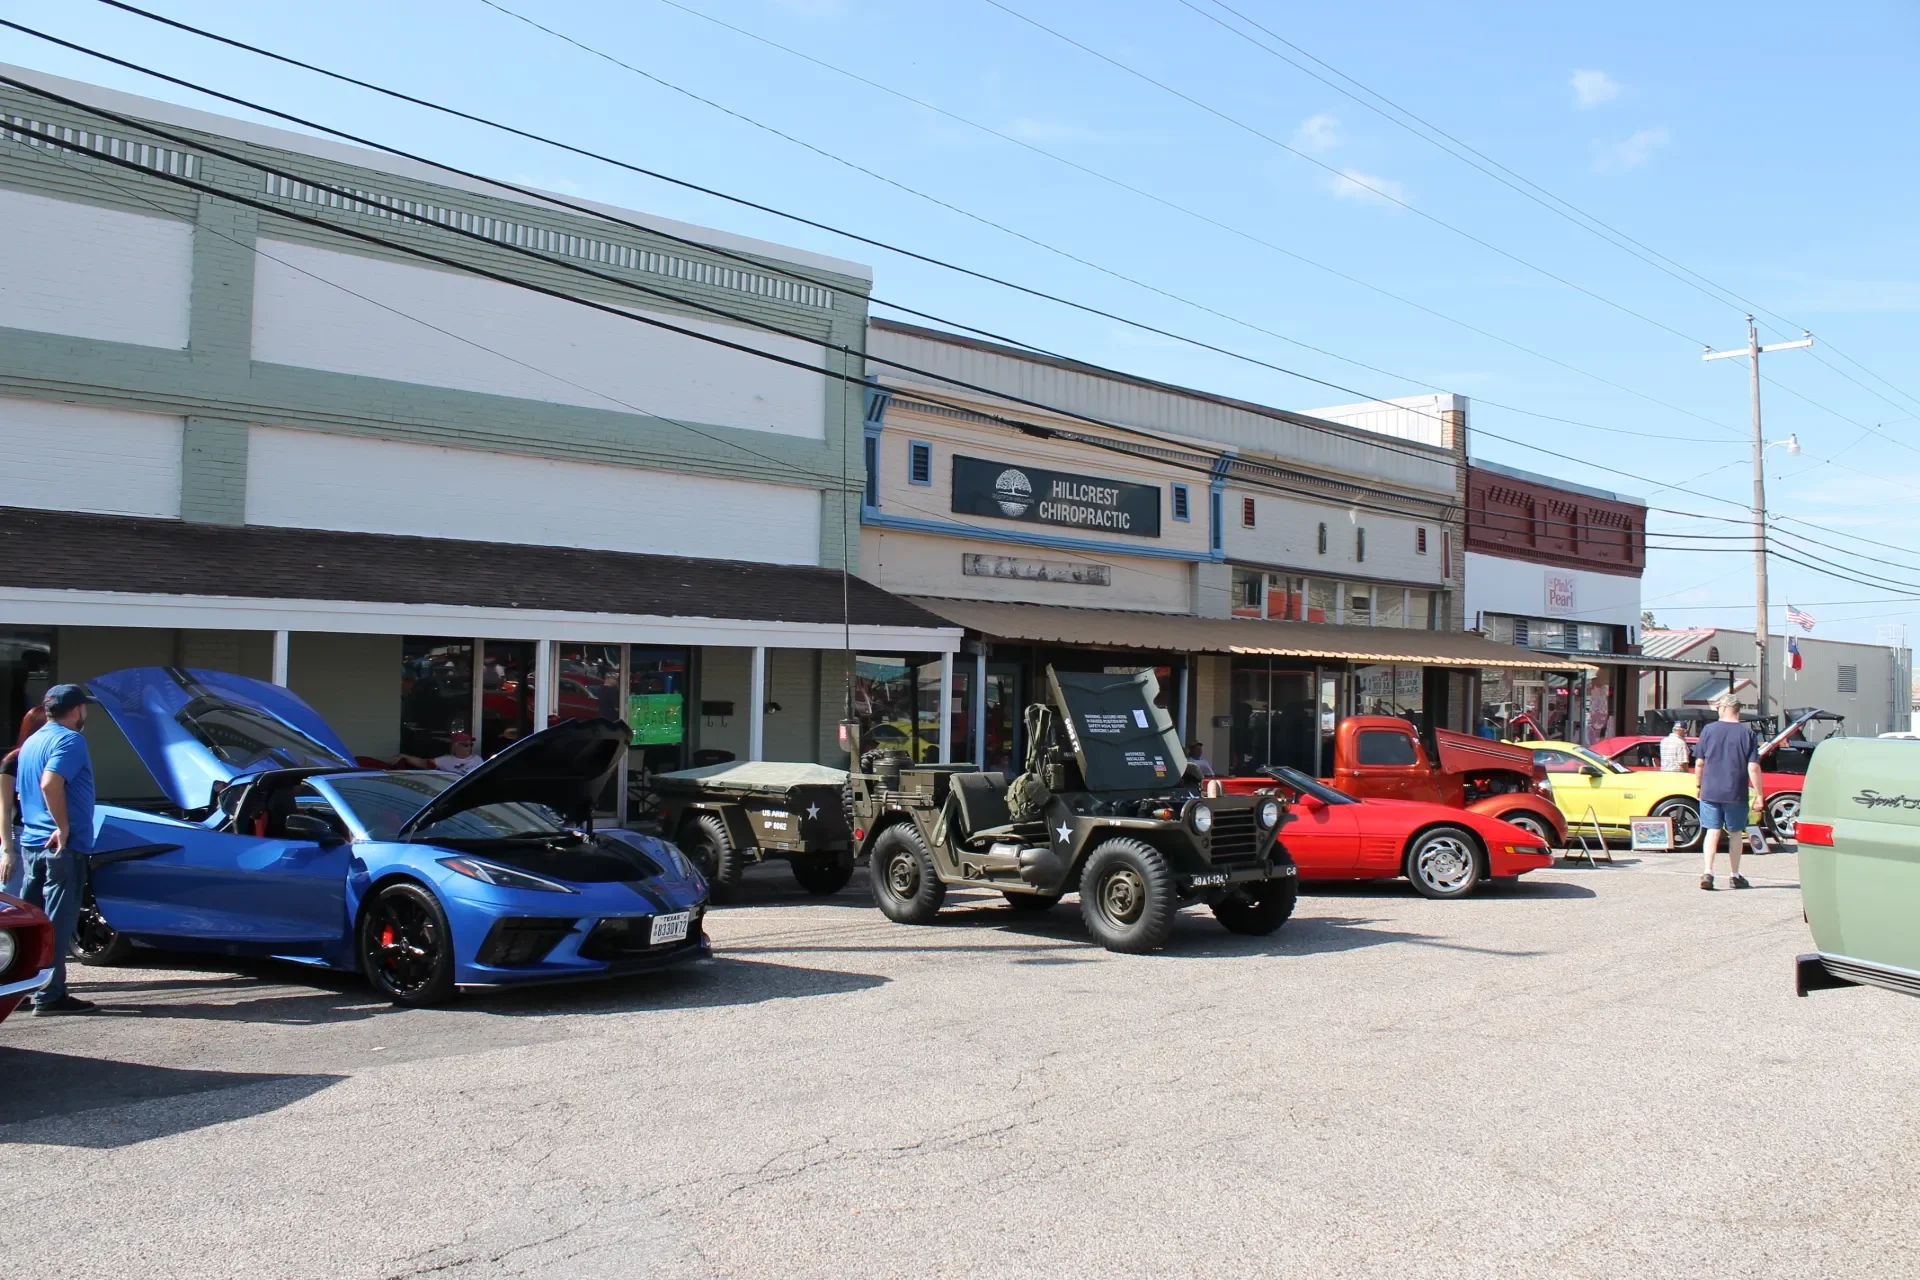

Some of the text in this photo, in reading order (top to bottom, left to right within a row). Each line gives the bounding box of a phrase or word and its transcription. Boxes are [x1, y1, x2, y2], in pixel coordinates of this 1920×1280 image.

[1052, 480, 1119, 506] HILLCREST
[1039, 501, 1131, 529] CHIROPRACTIC
[1553, 577, 1570, 593] Pink
[1549, 589, 1573, 608] Pearl
[632, 696, 650, 711] FOR
[637, 710, 671, 726] LEASE
[1852, 789, 1905, 808] Sport
[771, 810, 789, 819] ARMY
[663, 914, 681, 922] TEXAS
